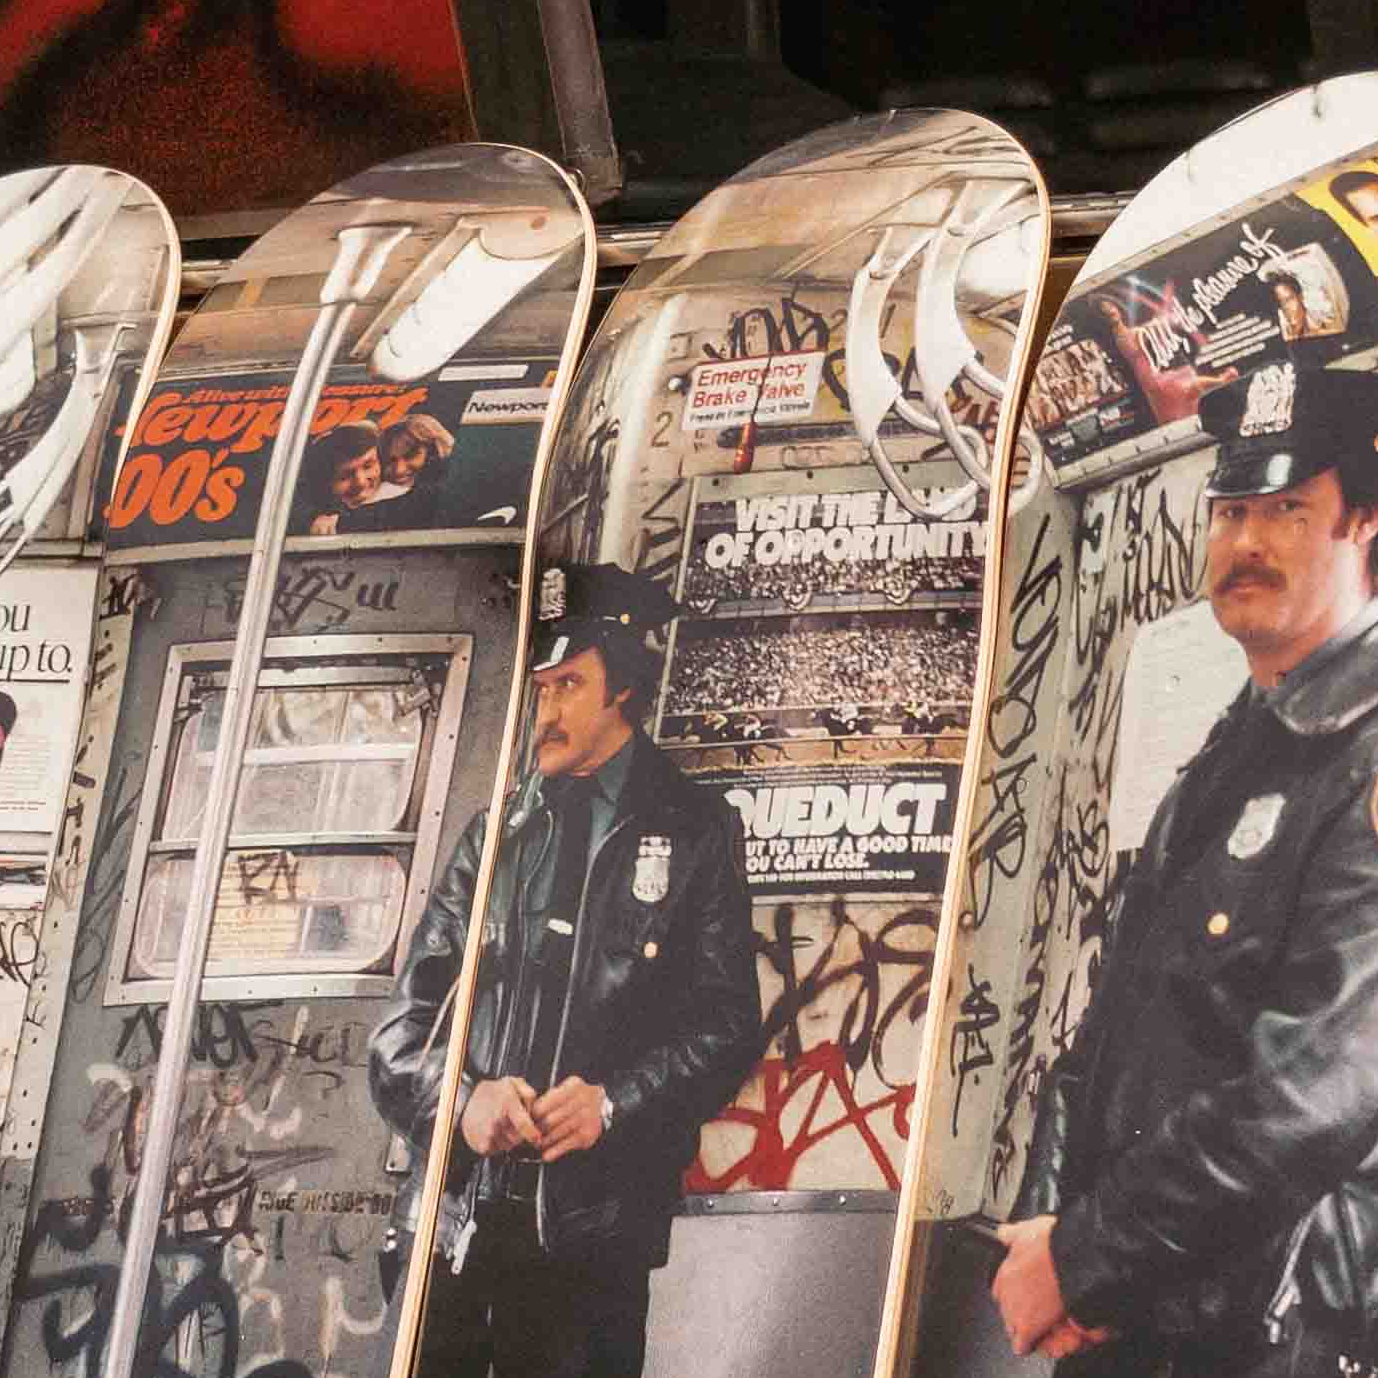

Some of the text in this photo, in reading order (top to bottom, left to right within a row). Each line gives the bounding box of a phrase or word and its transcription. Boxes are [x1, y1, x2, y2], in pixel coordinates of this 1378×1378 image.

[693, 388, 747, 409] Brake
[734, 494, 819, 532] VISIT
[821, 491, 881, 526] THE
[704, 531, 754, 569] OF
[768, 838, 792, 856] TO
[793, 836, 839, 855] HAVE
[838, 836, 854, 855] A
[856, 835, 909, 854] GOOD
[773, 853, 822, 871] CAN'T
